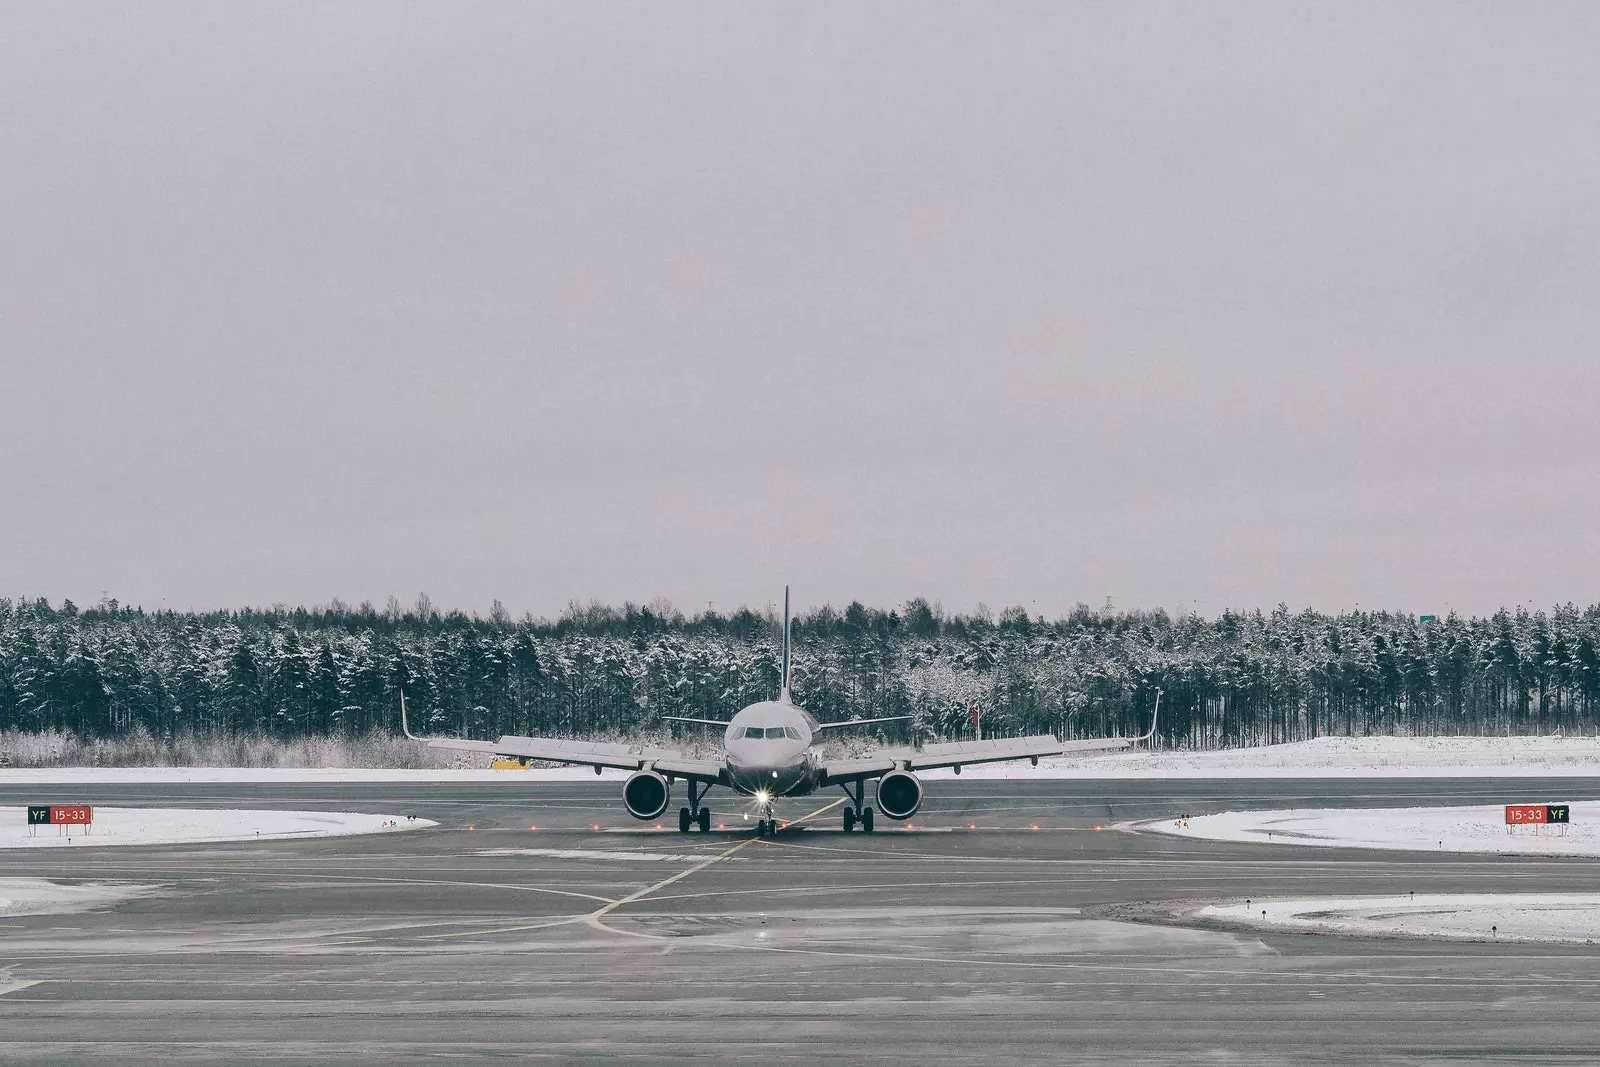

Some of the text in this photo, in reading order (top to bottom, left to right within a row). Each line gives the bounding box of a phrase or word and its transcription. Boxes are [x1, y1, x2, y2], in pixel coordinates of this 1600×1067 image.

[32, 810, 85, 820] YF 15-33
[1511, 810, 1565, 820] 15-33 YF
